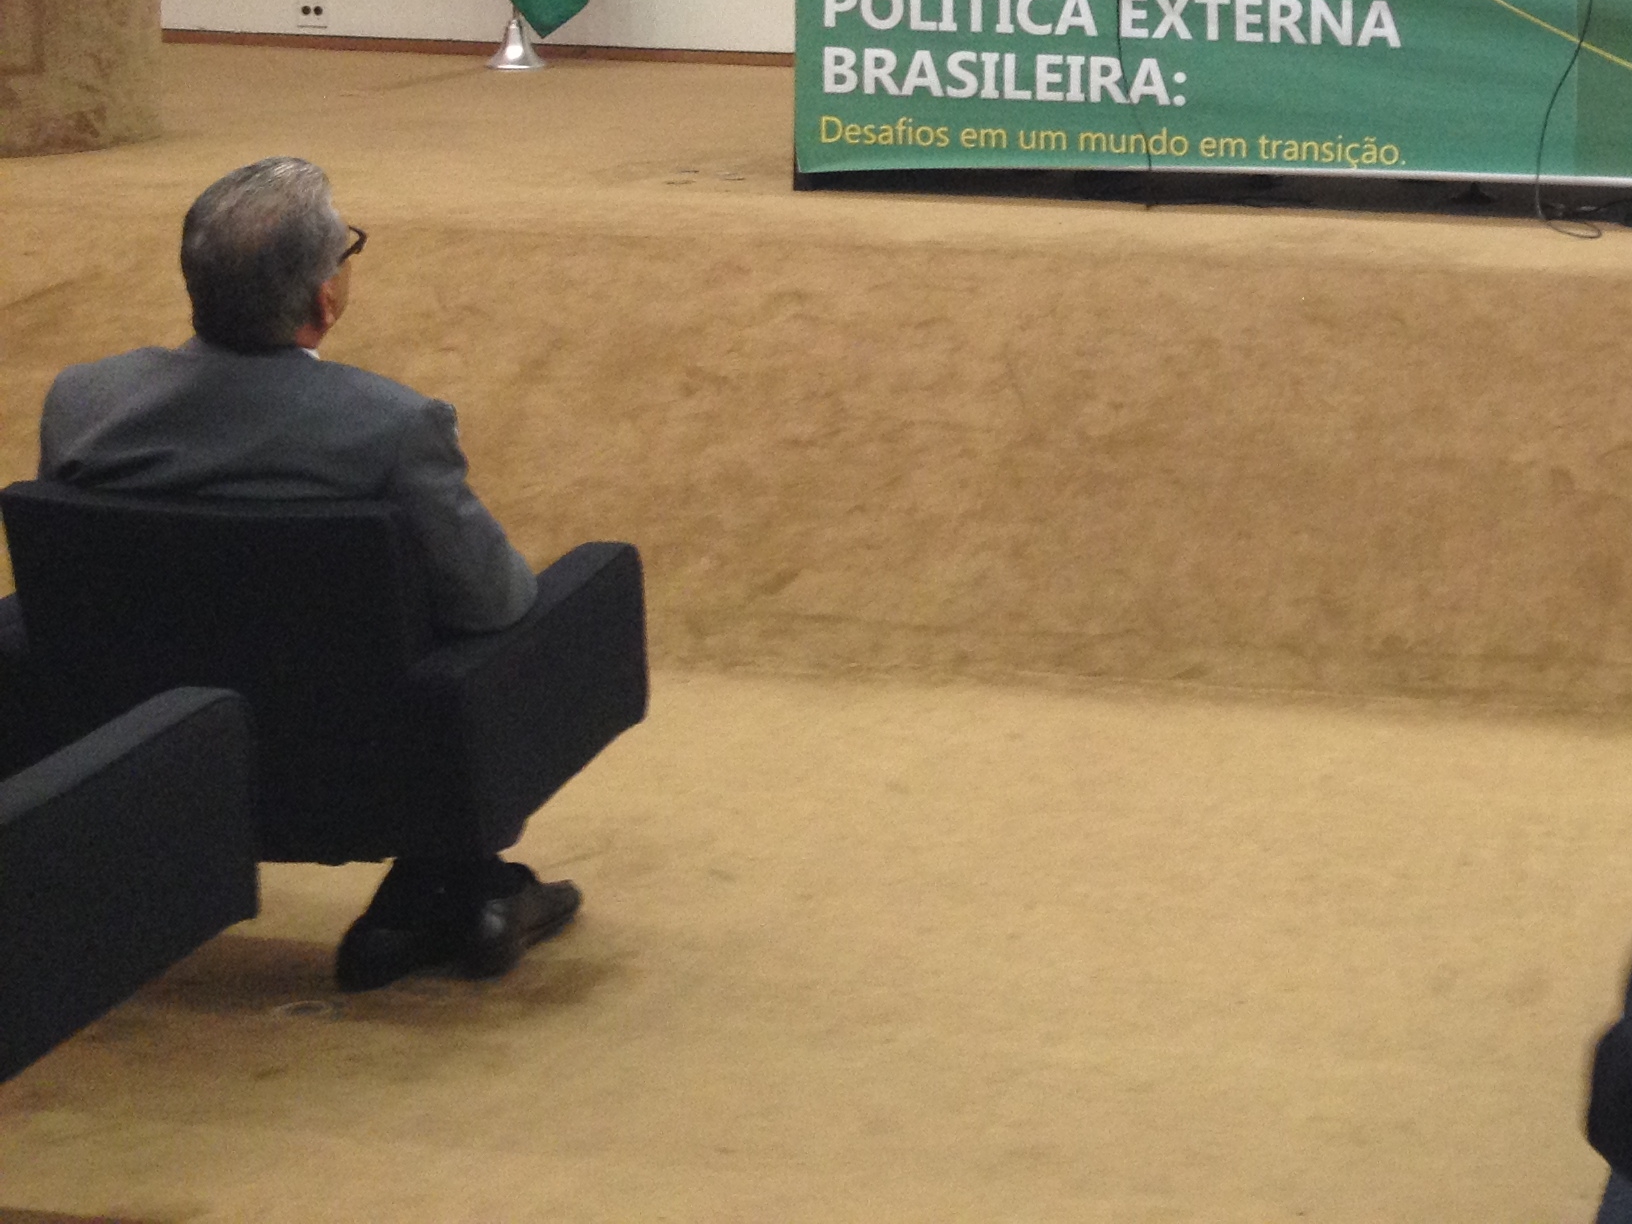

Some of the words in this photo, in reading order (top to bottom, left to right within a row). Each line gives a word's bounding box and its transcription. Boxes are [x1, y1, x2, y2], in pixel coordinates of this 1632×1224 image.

[823, 47, 1187, 107] BRASILEIRA:
[819, 115, 950, 147] Desafios
[960, 128, 1007, 148] em
[1019, 130, 1067, 151] um
[1079, 127, 1189, 157] mundo
[1200, 136, 1247, 158] em
[1258, 134, 1407, 169] transição.
